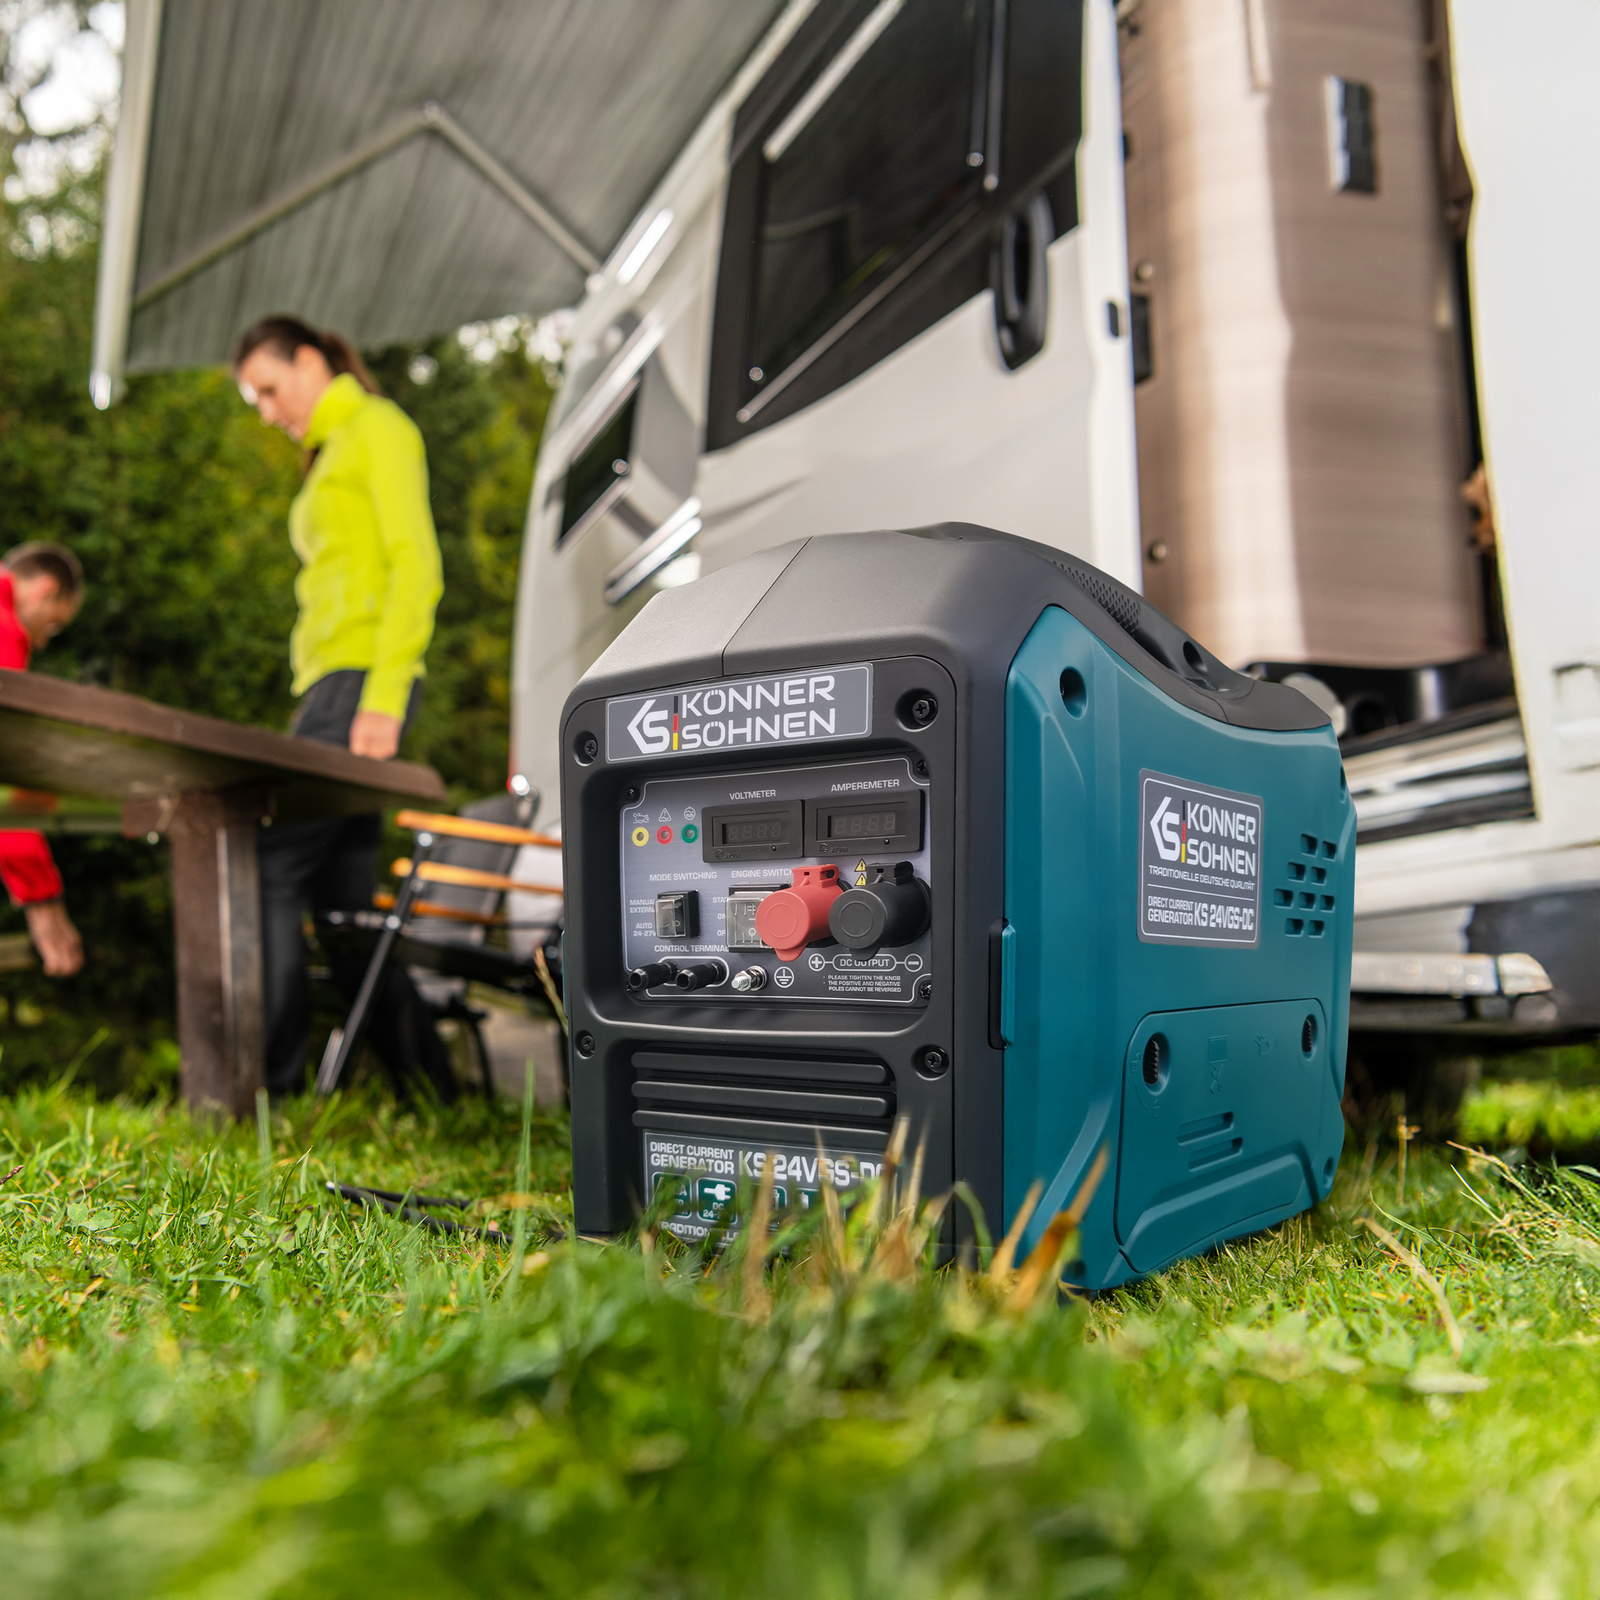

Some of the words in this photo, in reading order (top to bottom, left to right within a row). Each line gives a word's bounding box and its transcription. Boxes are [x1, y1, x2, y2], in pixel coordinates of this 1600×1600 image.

[682, 675, 835, 718] KÖNNER
[681, 708, 836, 749] SÖHNEN
[830, 779, 900, 792] AMPEREMETER
[729, 789, 776, 800] VOLTMETER
[1187, 801, 1256, 845] KÖNNER
[1186, 838, 1256, 877] SÖHNEN
[649, 873, 672, 881] MODE
[673, 871, 717, 881] SWITCHING
[731, 869, 761, 878] ENGINE
[1148, 864, 1199, 883] TRADITIONELLE
[1199, 874, 1229, 888] DEUTSCHE
[629, 898, 655, 906] MANUA
[712, 896, 727, 904] STA
[1147, 895, 1168, 908] DIRECT
[1168, 899, 1194, 911] CURRENT
[629, 906, 655, 914] EXTERN
[1147, 908, 1193, 925] GENERATOR
[1194, 902, 1208, 926] KS
[1209, 904, 1254, 930] 24VGS-DC
[716, 929, 726, 937] OF
[654, 944, 689, 952] CONTROL
[840, 958, 853, 967] DC
[650, 1141, 685, 1154] DIRECT
[686, 1145, 735, 1160] CURRENT
[650, 1153, 735, 1175] GENERATOR
[712, 1202, 724, 1211] DC
